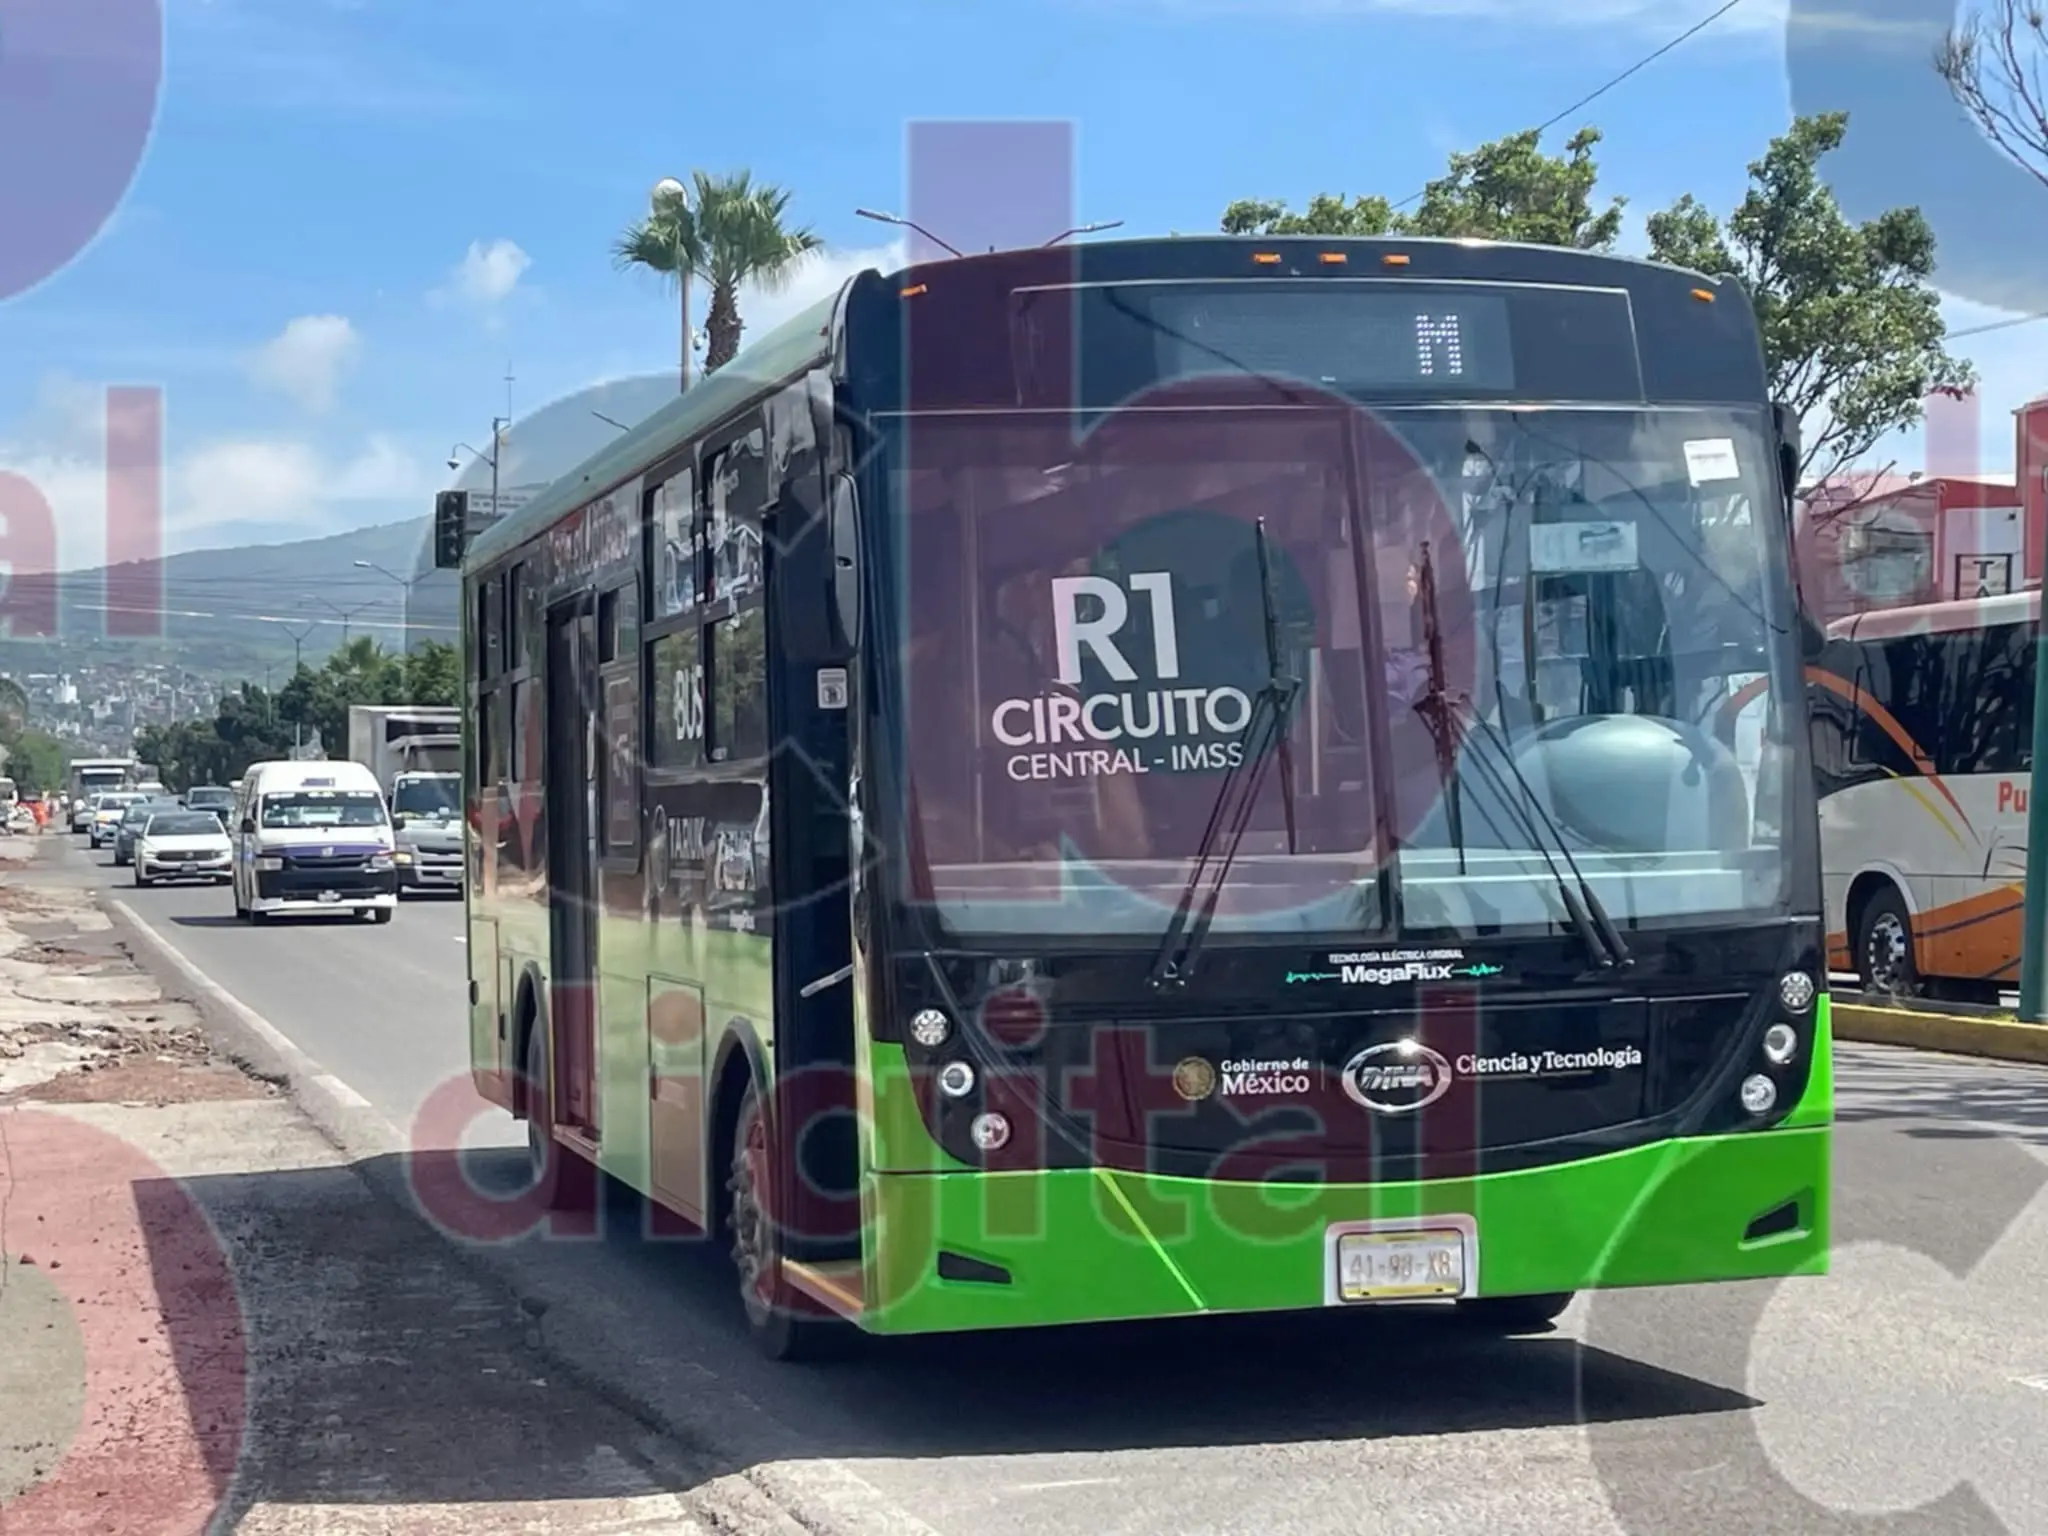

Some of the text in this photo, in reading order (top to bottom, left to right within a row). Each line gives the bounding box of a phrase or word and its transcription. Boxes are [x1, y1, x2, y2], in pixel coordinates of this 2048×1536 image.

[1415, 314, 1463, 375] M
[1051, 571, 1180, 684] R1
[673, 665, 705, 741] BUS
[991, 686, 1253, 746] CIRCUITO
[1006, 747, 1150, 781] CENTRAL
[1171, 741, 1244, 771] IMSS
[1341, 962, 1454, 985] MegaFlux
[1221, 1056, 1309, 1072] Gobierno de
[1456, 1045, 1642, 1074] Ciencia y Tecnología
[1221, 1071, 1310, 1096] México
